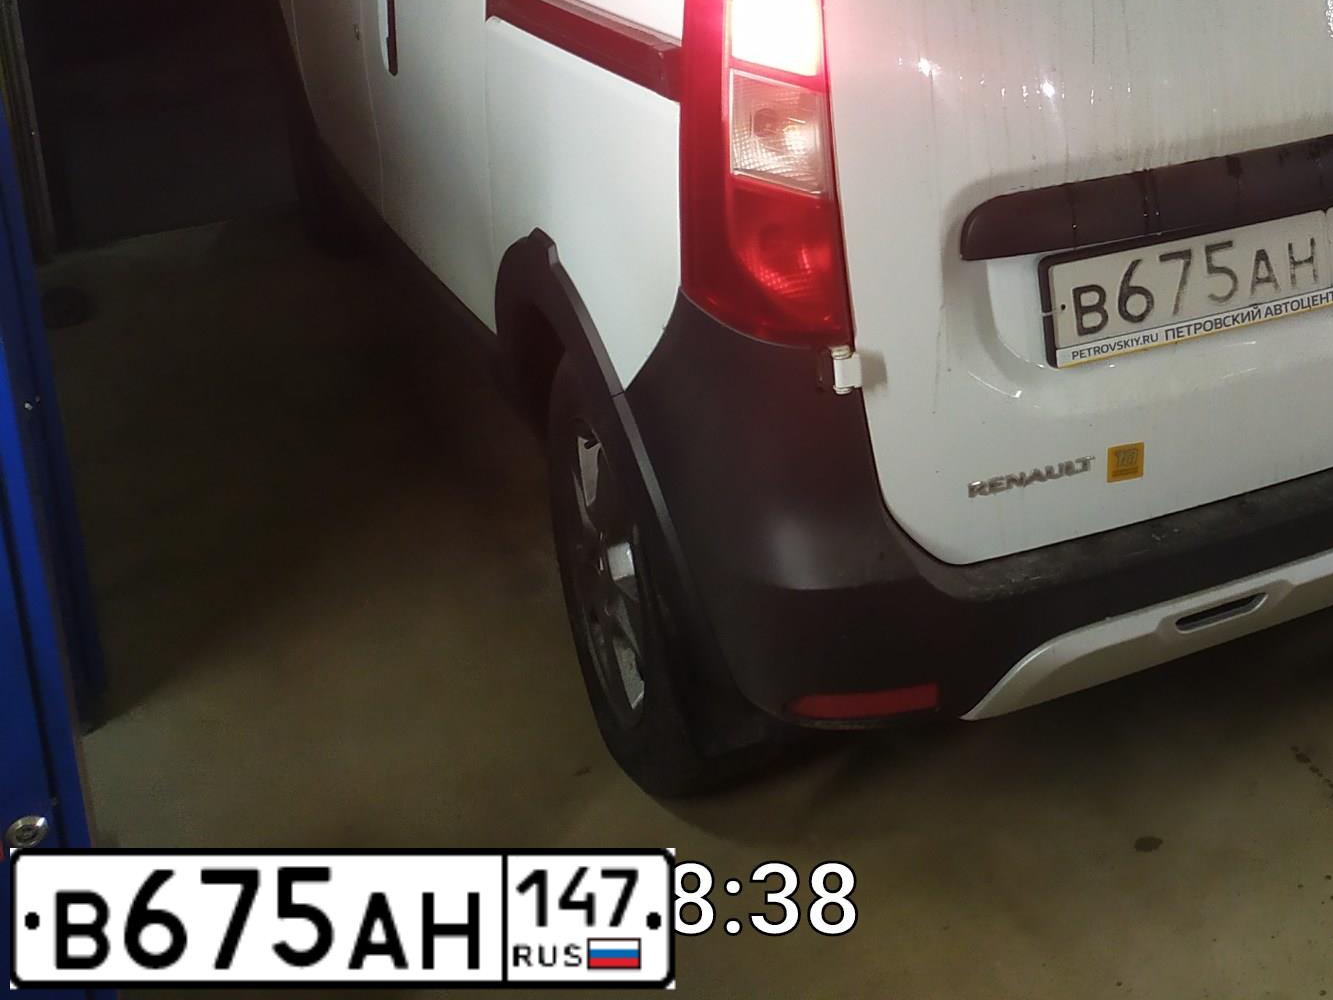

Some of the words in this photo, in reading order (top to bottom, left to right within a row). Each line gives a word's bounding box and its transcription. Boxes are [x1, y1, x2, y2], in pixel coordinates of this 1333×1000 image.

[1071, 333, 1159, 361] PETROVSKIY.RU
[1164, 304, 1263, 341] ПЕТРОВСКИЙ
[967, 455, 1096, 498] RENAULT
